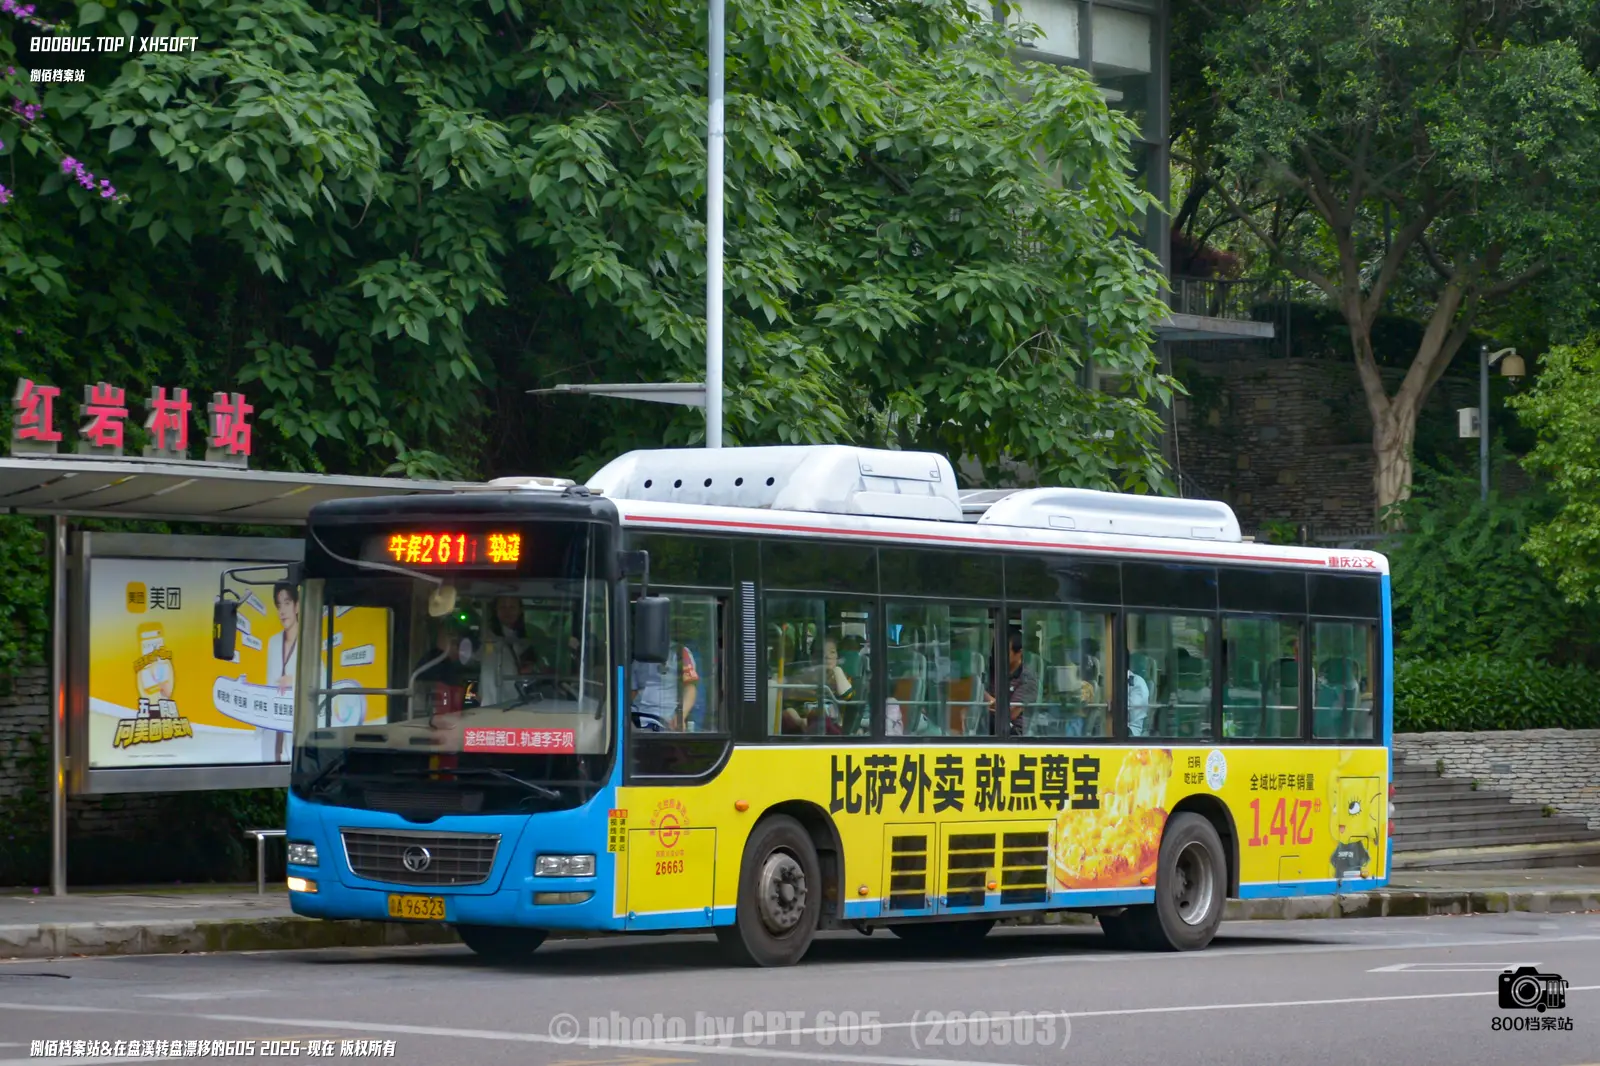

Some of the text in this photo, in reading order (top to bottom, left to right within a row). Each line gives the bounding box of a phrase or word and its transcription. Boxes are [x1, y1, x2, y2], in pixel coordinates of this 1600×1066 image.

[14, 377, 254, 456] 红岩村站
[1328, 556, 1377, 569] 重庆公交
[150, 586, 182, 610] 美团
[829, 753, 1100, 816] 比萨外卖 就点尊宝
[1249, 773, 1315, 792] 全域比萨年销量
[655, 859, 684, 876] 26663
